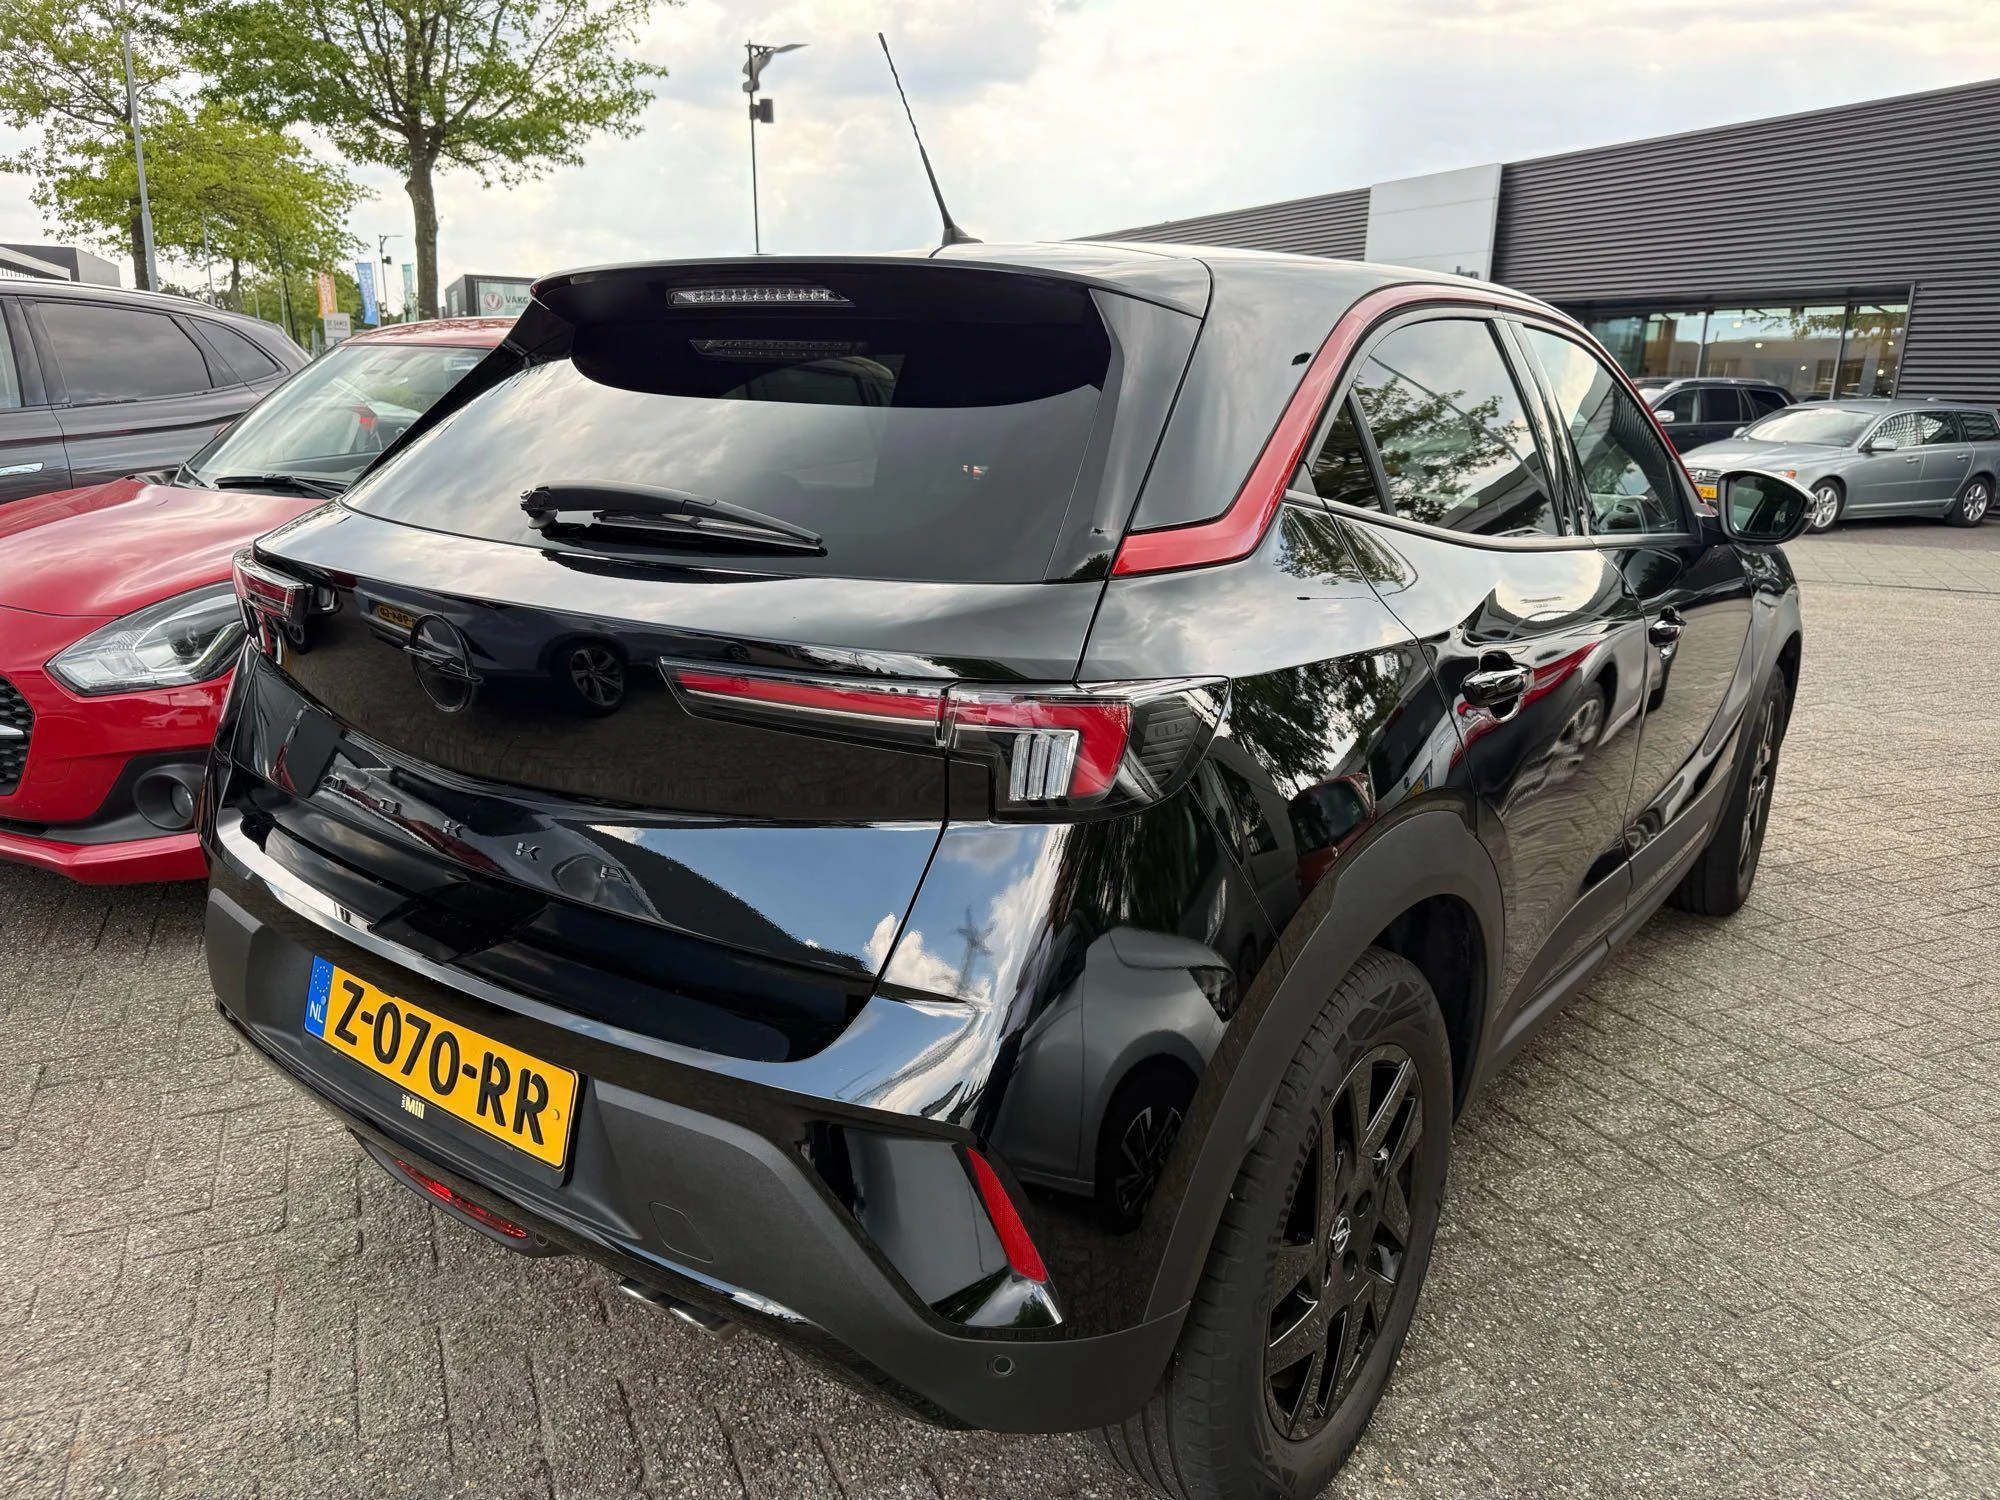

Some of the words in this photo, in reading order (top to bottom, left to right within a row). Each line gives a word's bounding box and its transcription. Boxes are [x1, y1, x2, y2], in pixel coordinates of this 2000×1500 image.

[322, 774, 631, 885] MOKKA
[309, 1001, 324, 1024] NL
[334, 979, 549, 1146] Z-070-RR
